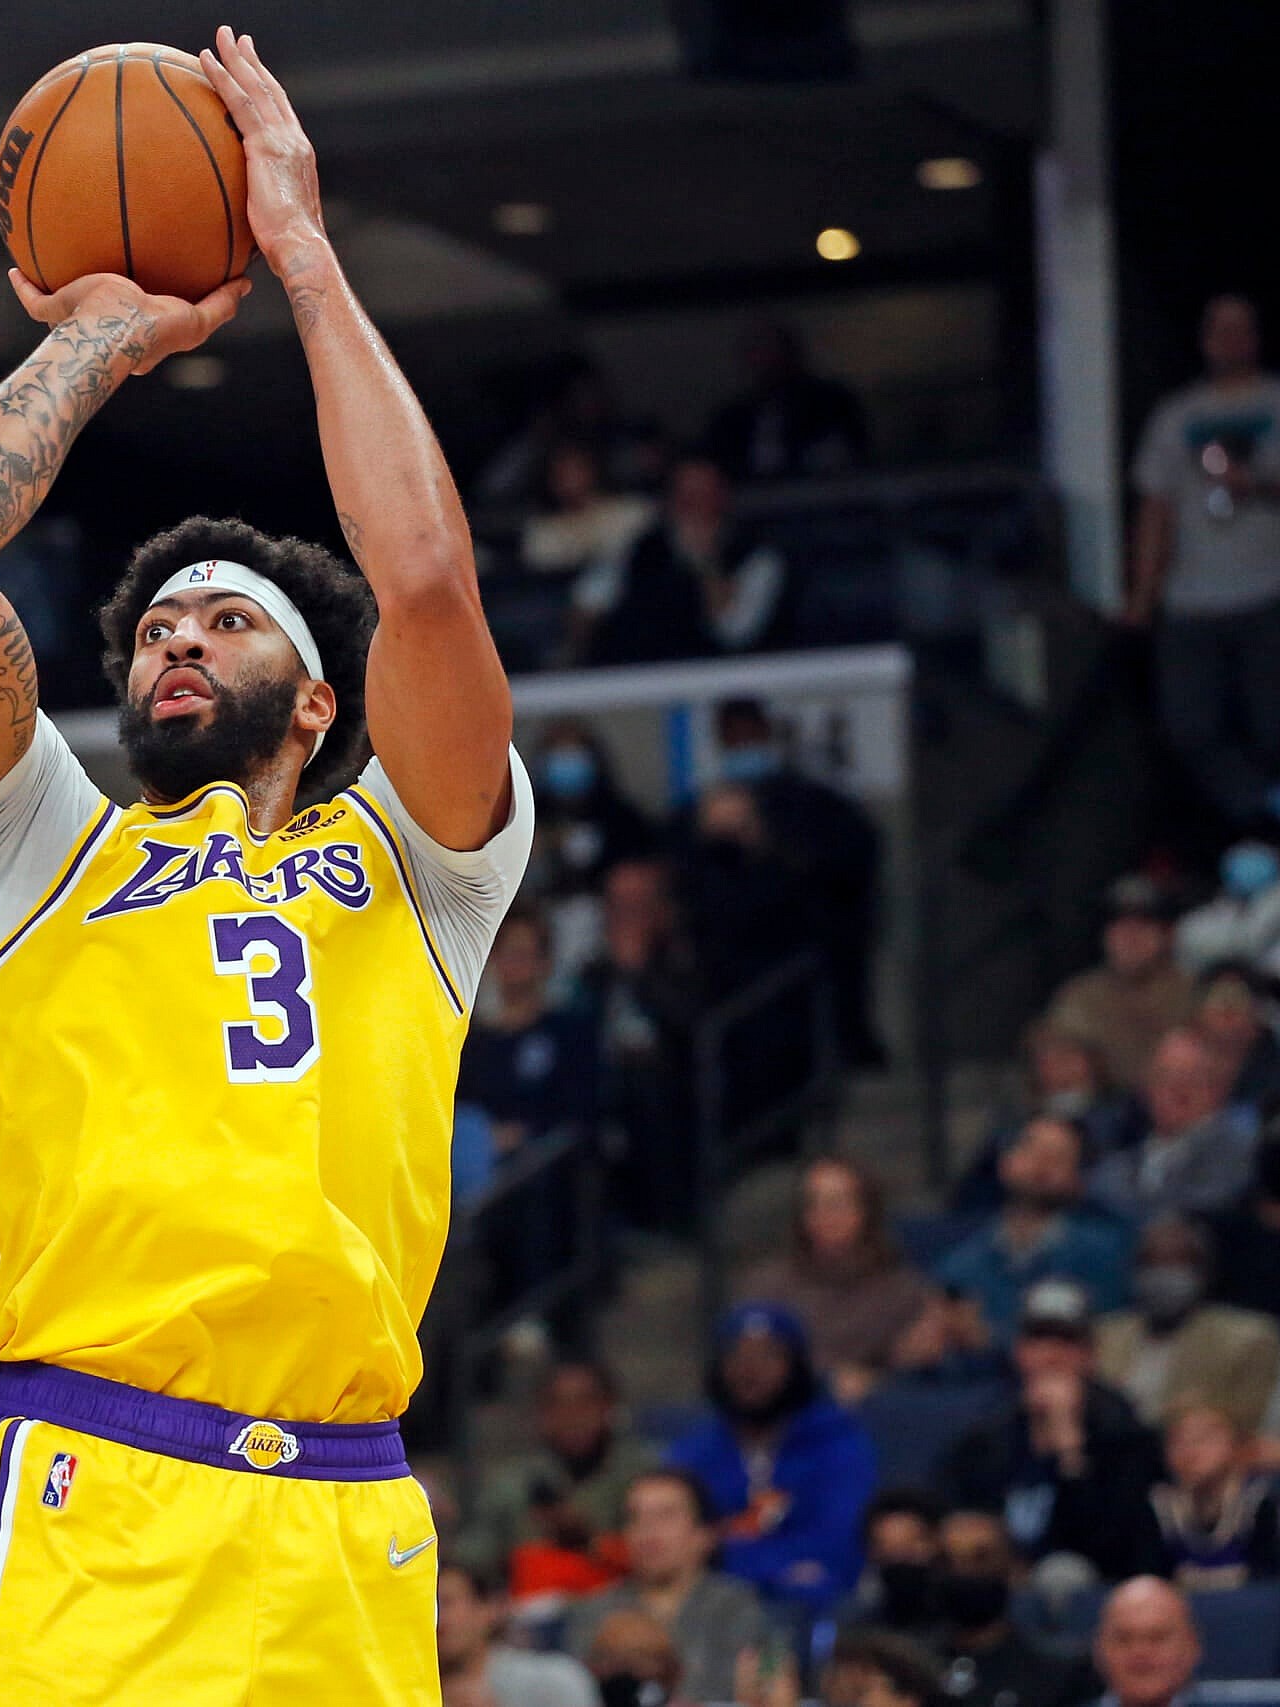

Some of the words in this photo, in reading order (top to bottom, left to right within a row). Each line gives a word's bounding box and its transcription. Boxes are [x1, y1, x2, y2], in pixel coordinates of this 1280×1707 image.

[81, 832, 374, 925] LAKERS
[208, 912, 321, 1084] 3
[229, 1430, 300, 1462] LAKERS
[45, 1490, 56, 1503] 75
